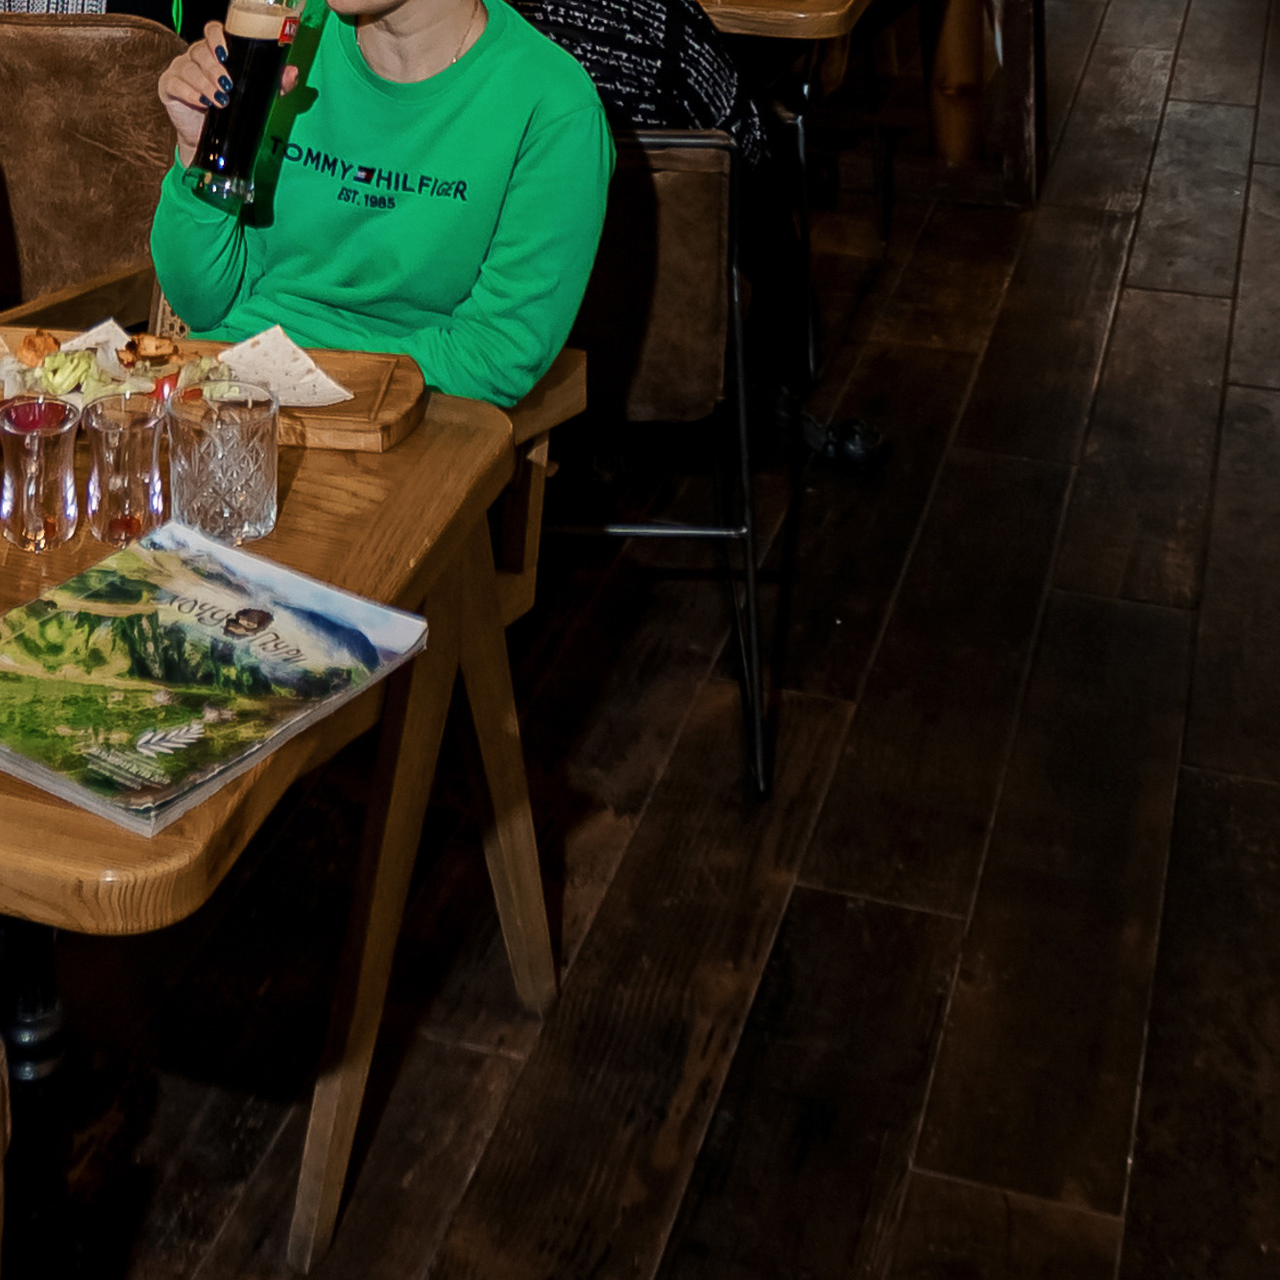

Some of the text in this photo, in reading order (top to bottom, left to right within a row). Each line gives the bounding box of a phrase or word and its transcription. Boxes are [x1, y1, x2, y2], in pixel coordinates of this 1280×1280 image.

[270, 136, 468, 202] TOMMY HILFIGER
[337, 186, 361, 207] EST.
